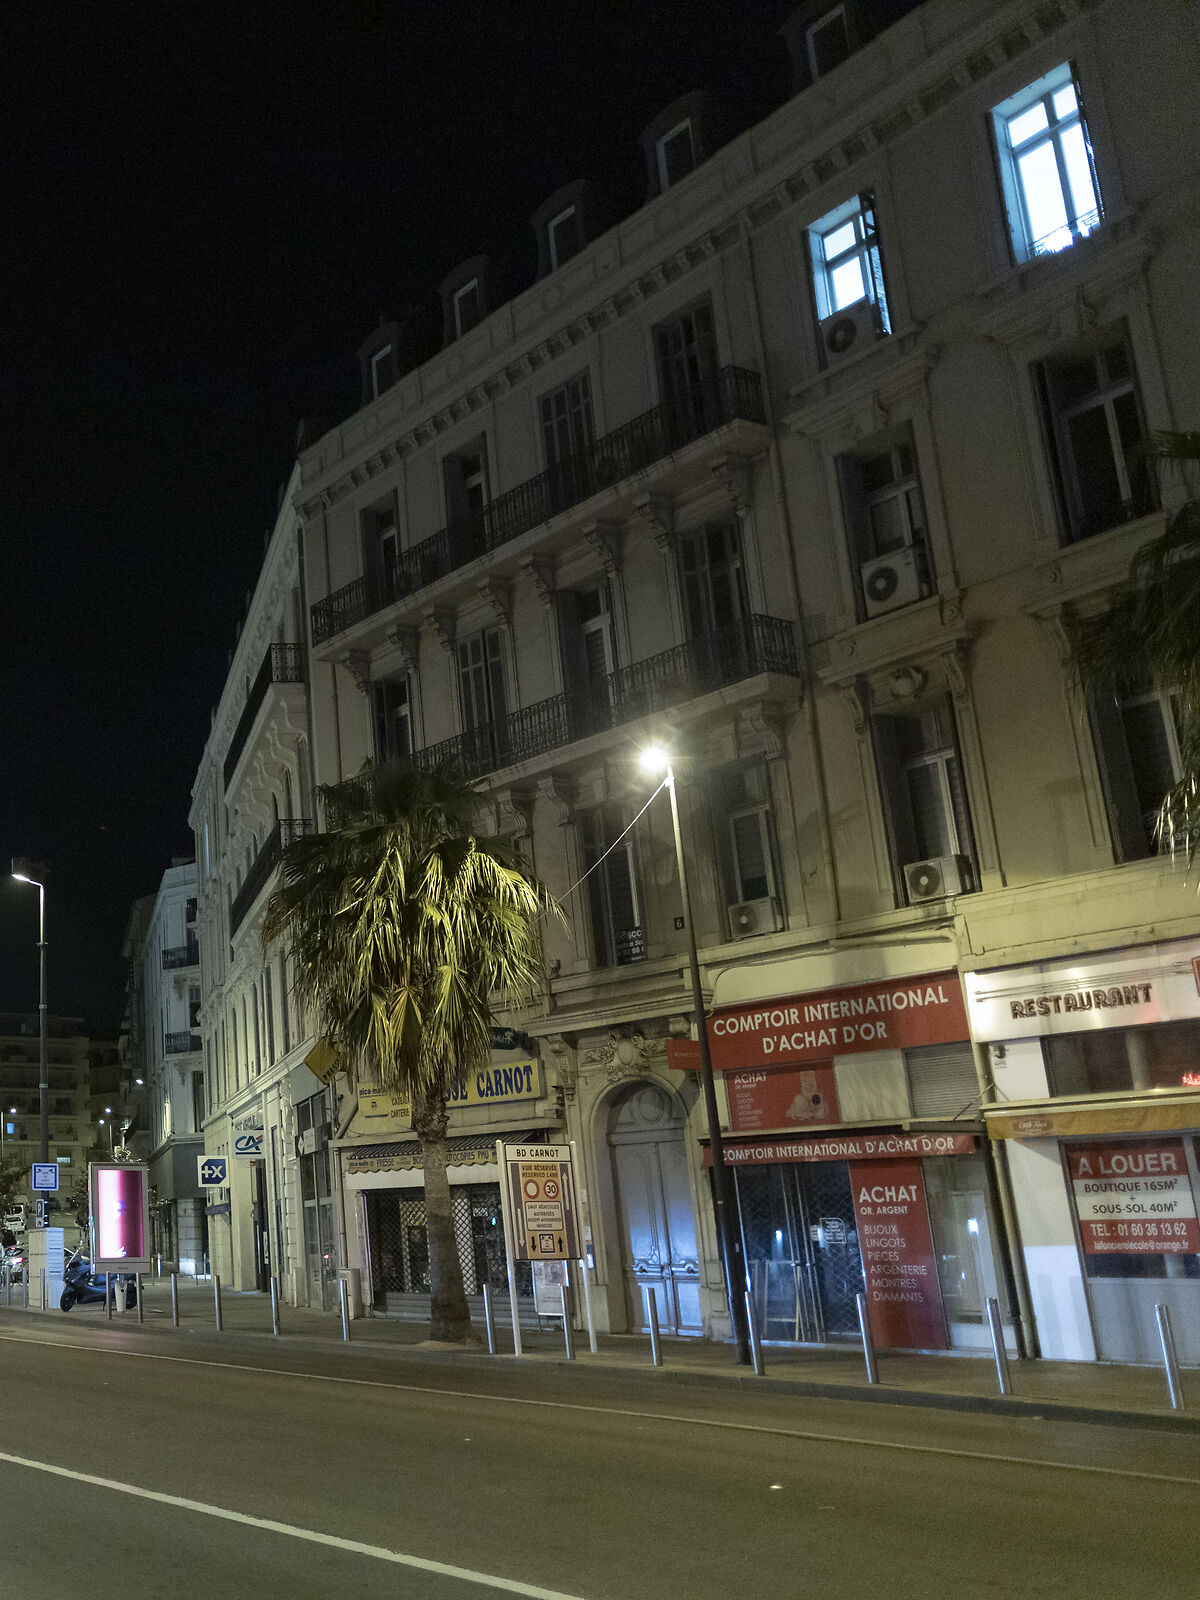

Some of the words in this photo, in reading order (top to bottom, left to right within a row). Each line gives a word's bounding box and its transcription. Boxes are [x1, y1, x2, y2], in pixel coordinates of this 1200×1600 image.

[676, 918, 682, 928] 6
[1010, 983, 1152, 1019] RESTAURANT
[713, 1008, 800, 1035] COMPTOIR
[804, 985, 949, 1023] INTERNATIONAL
[762, 1028, 837, 1054] D'ACHAT
[843, 1021, 887, 1043] D'OR
[476, 1065, 533, 1098] CARNOT
[734, 1072, 767, 1084] ACHAT
[516, 1149, 527, 1157] BD
[529, 1149, 559, 1157] CARNOT
[722, 1147, 774, 1161] COMPTOIR
[776, 1141, 863, 1158] INTERNATIONAL
[865, 1139, 918, 1153] D'ACHAT
[921, 1137, 955, 1151] D'OR
[446, 1151, 475, 1162] OTOCOPIES
[376, 1158, 394, 1167] PRESSE
[1078, 1156, 1093, 1175] A
[1098, 1152, 1178, 1174] LOUER
[547, 1185, 556, 1194] 30
[1084, 1181, 1141, 1193] BOUTIQUE
[859, 1185, 917, 1203] ACHAT
[876, 1205, 908, 1215] ARGENT
[1092, 1203, 1147, 1214] SOUS-SOL
[864, 1224, 898, 1235] BIJOUX
[1090, 1223, 1110, 1236] TEL
[1118, 1224, 1128, 1236] 01
[1131, 1223, 1143, 1236] 60
[1145, 1223, 1158, 1236] 36
[1160, 1223, 1172, 1236] 13
[1174, 1222, 1187, 1235] 62
[866, 1238, 906, 1248] LINGOTS
[868, 1251, 899, 1261] PIECES
[870, 1265, 928, 1275] ARGENTERIE
[871, 1278, 917, 1288] MONTRES
[873, 1291, 923, 1302] DIAMANTS
